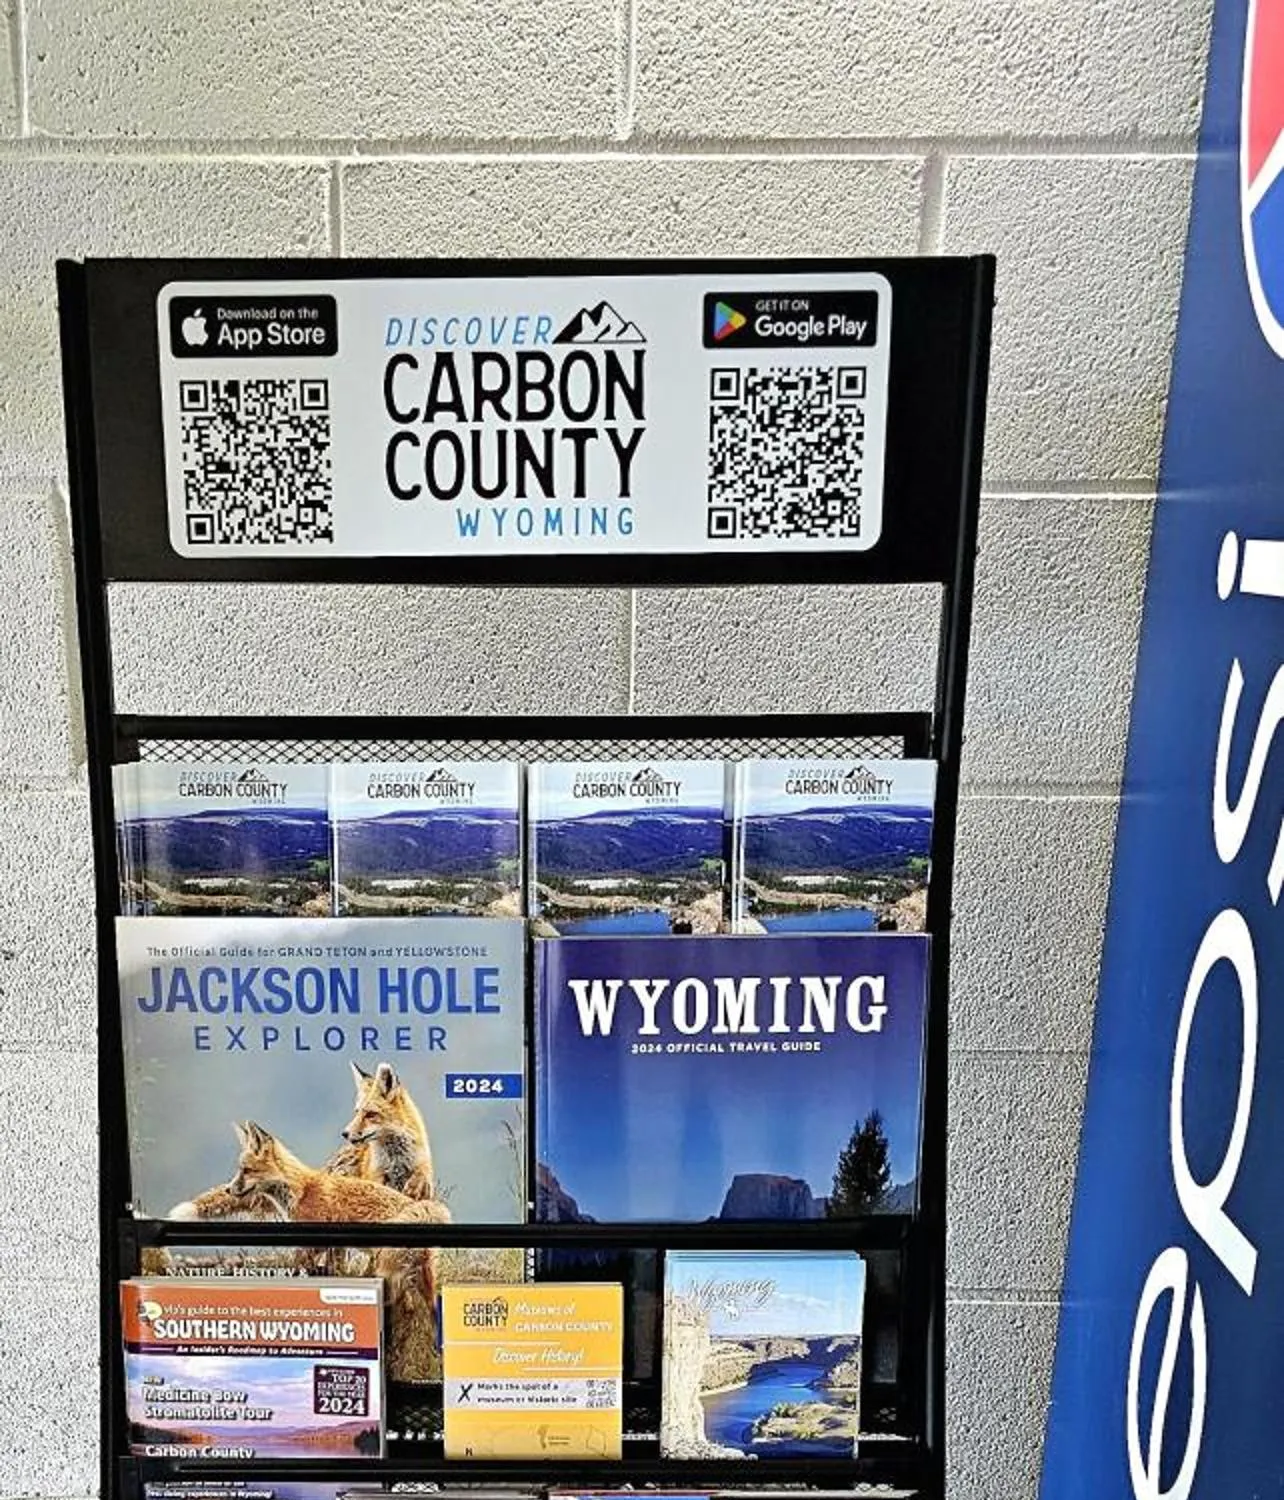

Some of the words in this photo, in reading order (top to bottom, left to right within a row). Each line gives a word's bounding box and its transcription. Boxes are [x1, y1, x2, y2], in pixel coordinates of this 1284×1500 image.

[217, 307, 277, 320] Download
[280, 309, 295, 319] on
[298, 307, 319, 320] the
[755, 300, 778, 312] GET
[791, 300, 809, 311] ON
[385, 316, 552, 345] DISCOVER
[755, 315, 825, 341] Google
[827, 314, 868, 341] Play
[217, 322, 263, 350] App
[267, 321, 325, 345] Store
[384, 349, 647, 424] CARBON
[385, 428, 647, 500] COUNTY
[457, 507, 634, 537] WYOMING
[180, 771, 238, 782] DISCOVER
[369, 772, 426, 782] DISCOVER
[575, 771, 632, 781] DISCOVER
[788, 769, 845, 779] DISCOVER
[179, 783, 233, 798] CARBON
[236, 783, 288, 798] COUNTY
[368, 784, 421, 798] CARBON
[424, 783, 475, 799] COUNTY
[573, 782, 627, 798] CARBON
[629, 782, 681, 798] COUNTY
[785, 779, 839, 795] CARBON
[843, 779, 894, 796] COUNTY
[147, 946, 168, 957] The
[171, 946, 216, 957] Official
[220, 946, 254, 957] Guide
[257, 946, 275, 957] for
[278, 947, 323, 957] GRAND
[325, 947, 367, 957] TETON
[370, 947, 393, 957] and
[395, 947, 488, 957] YELLOWSTONE
[138, 966, 360, 1014] JACKSON
[380, 967, 500, 1014] HOLE
[568, 975, 888, 1036] WYOMING
[194, 1026, 448, 1051] EXPLORER
[632, 1044, 662, 1055] 2024
[667, 1043, 724, 1053] OFFICIAL
[729, 1042, 777, 1052] TRAVEL
[782, 1041, 821, 1052] GUIDE
[452, 1079, 503, 1094] 2024
[187, 1305, 214, 1317] guide
[217, 1306, 228, 1316] to
[230, 1306, 247, 1316] the
[333, 1308, 343, 1317] in
[464, 1303, 508, 1316] CARBON
[464, 1316, 507, 1327] COUNTY
[154, 1319, 256, 1340] SOUTHERN
[260, 1322, 355, 1343] WYOMING
[143, 1387, 212, 1402] Medicine
[214, 1389, 248, 1402] Bow
[458, 1384, 473, 1404] X
[239, 1407, 273, 1419] Tour
[319, 1398, 365, 1415] 2024
[146, 1446, 198, 1458] Carbon
[202, 1447, 254, 1458] County
